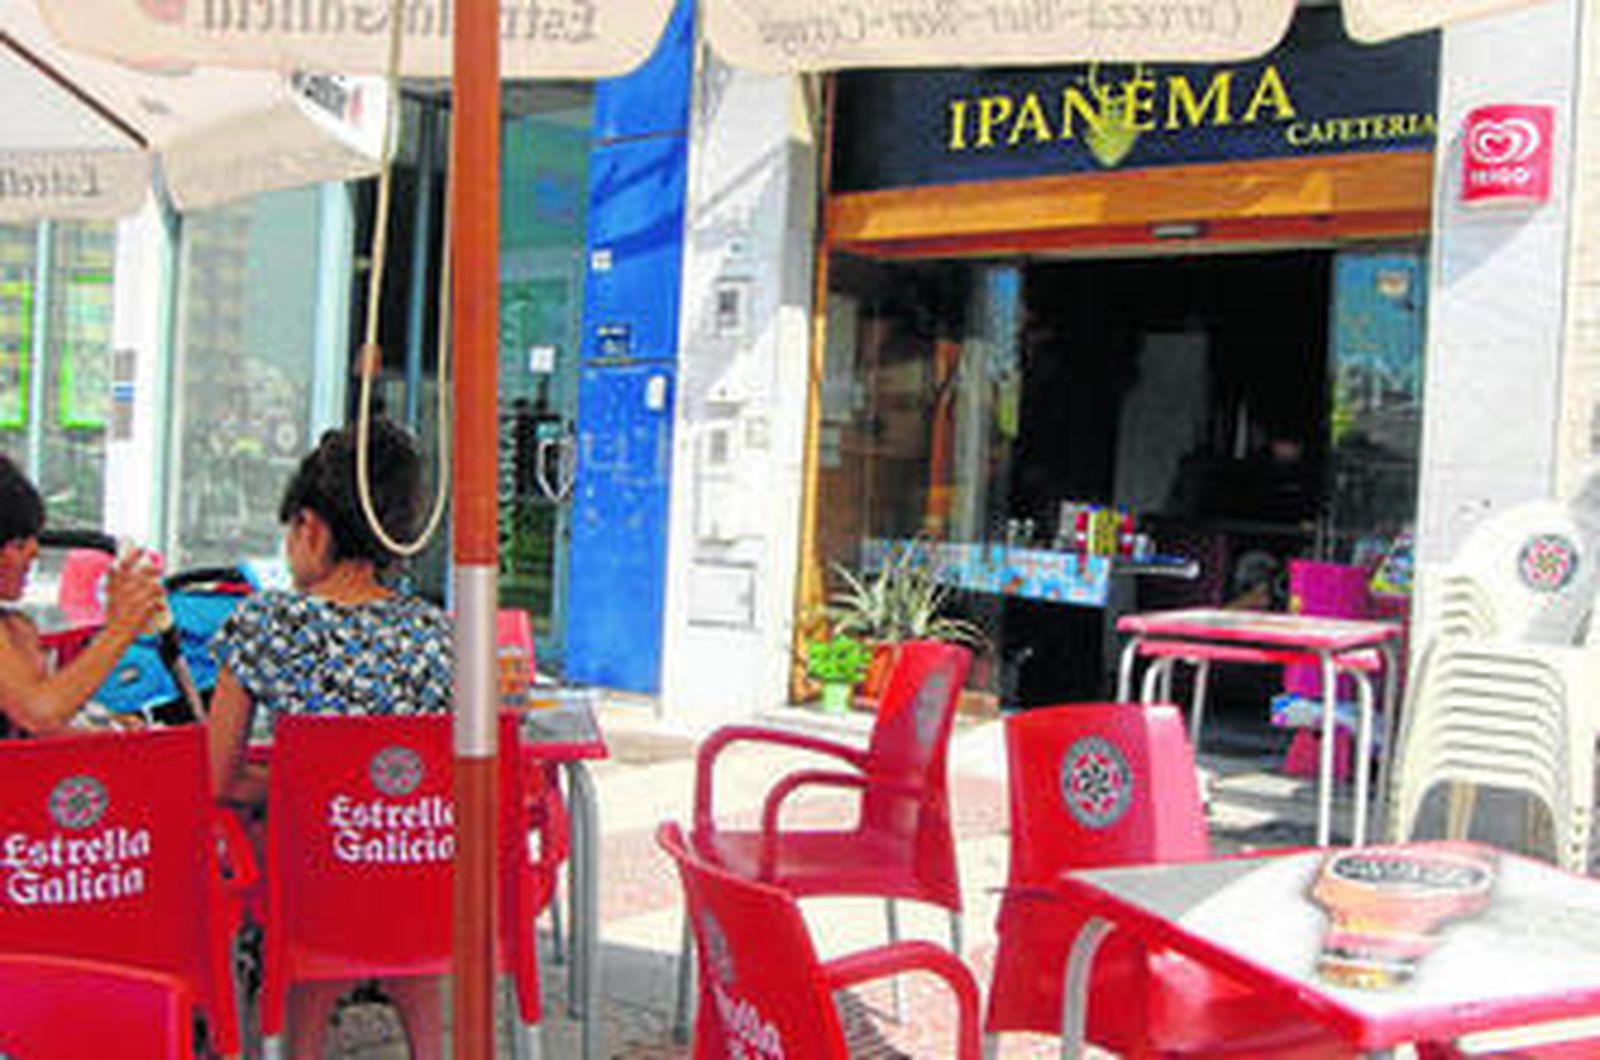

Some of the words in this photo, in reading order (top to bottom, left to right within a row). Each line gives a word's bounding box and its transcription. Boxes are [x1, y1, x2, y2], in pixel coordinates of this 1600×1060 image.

[950, 63, 1296, 150] IPANEMA
[1287, 114, 1437, 146] CAFETERIA
[0, 827, 150, 868] Estrella
[333, 829, 456, 863] Galicia
[7, 863, 145, 905] Galicia
